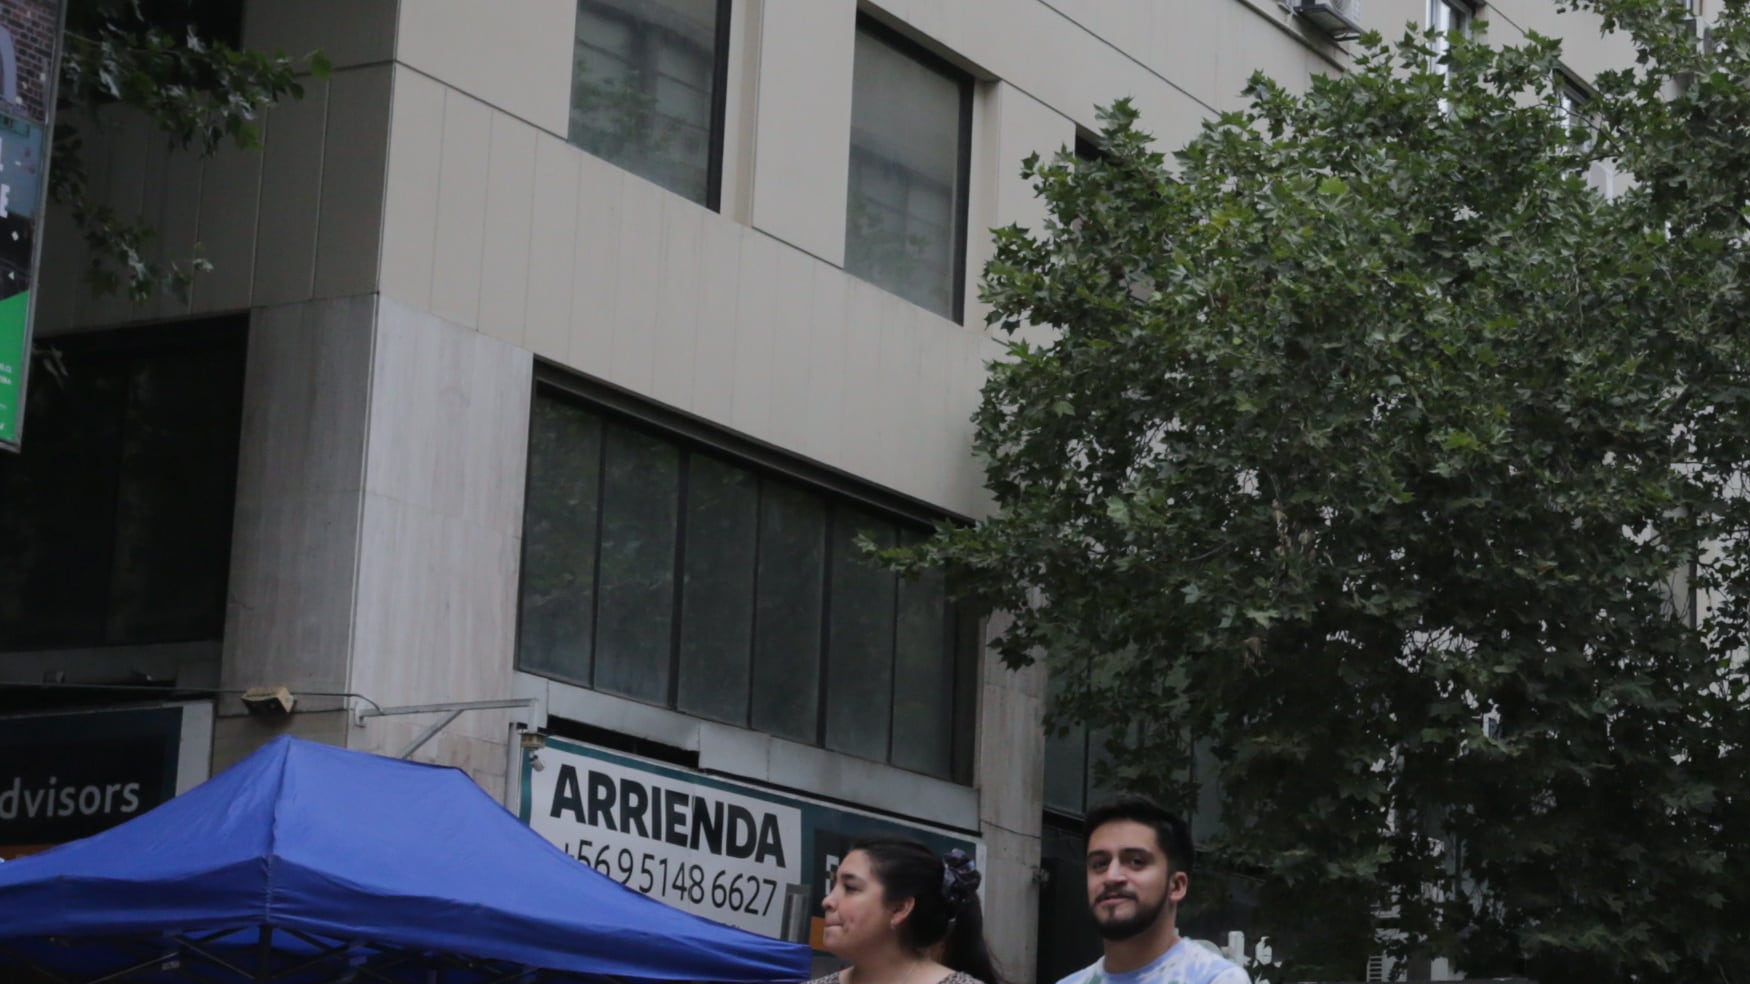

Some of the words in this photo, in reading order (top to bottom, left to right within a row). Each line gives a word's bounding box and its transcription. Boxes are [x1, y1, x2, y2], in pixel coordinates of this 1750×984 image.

[550, 764, 786, 868] ARRIENDA
[639, 853, 704, 904] 5148
[711, 870, 777, 917] 6627
